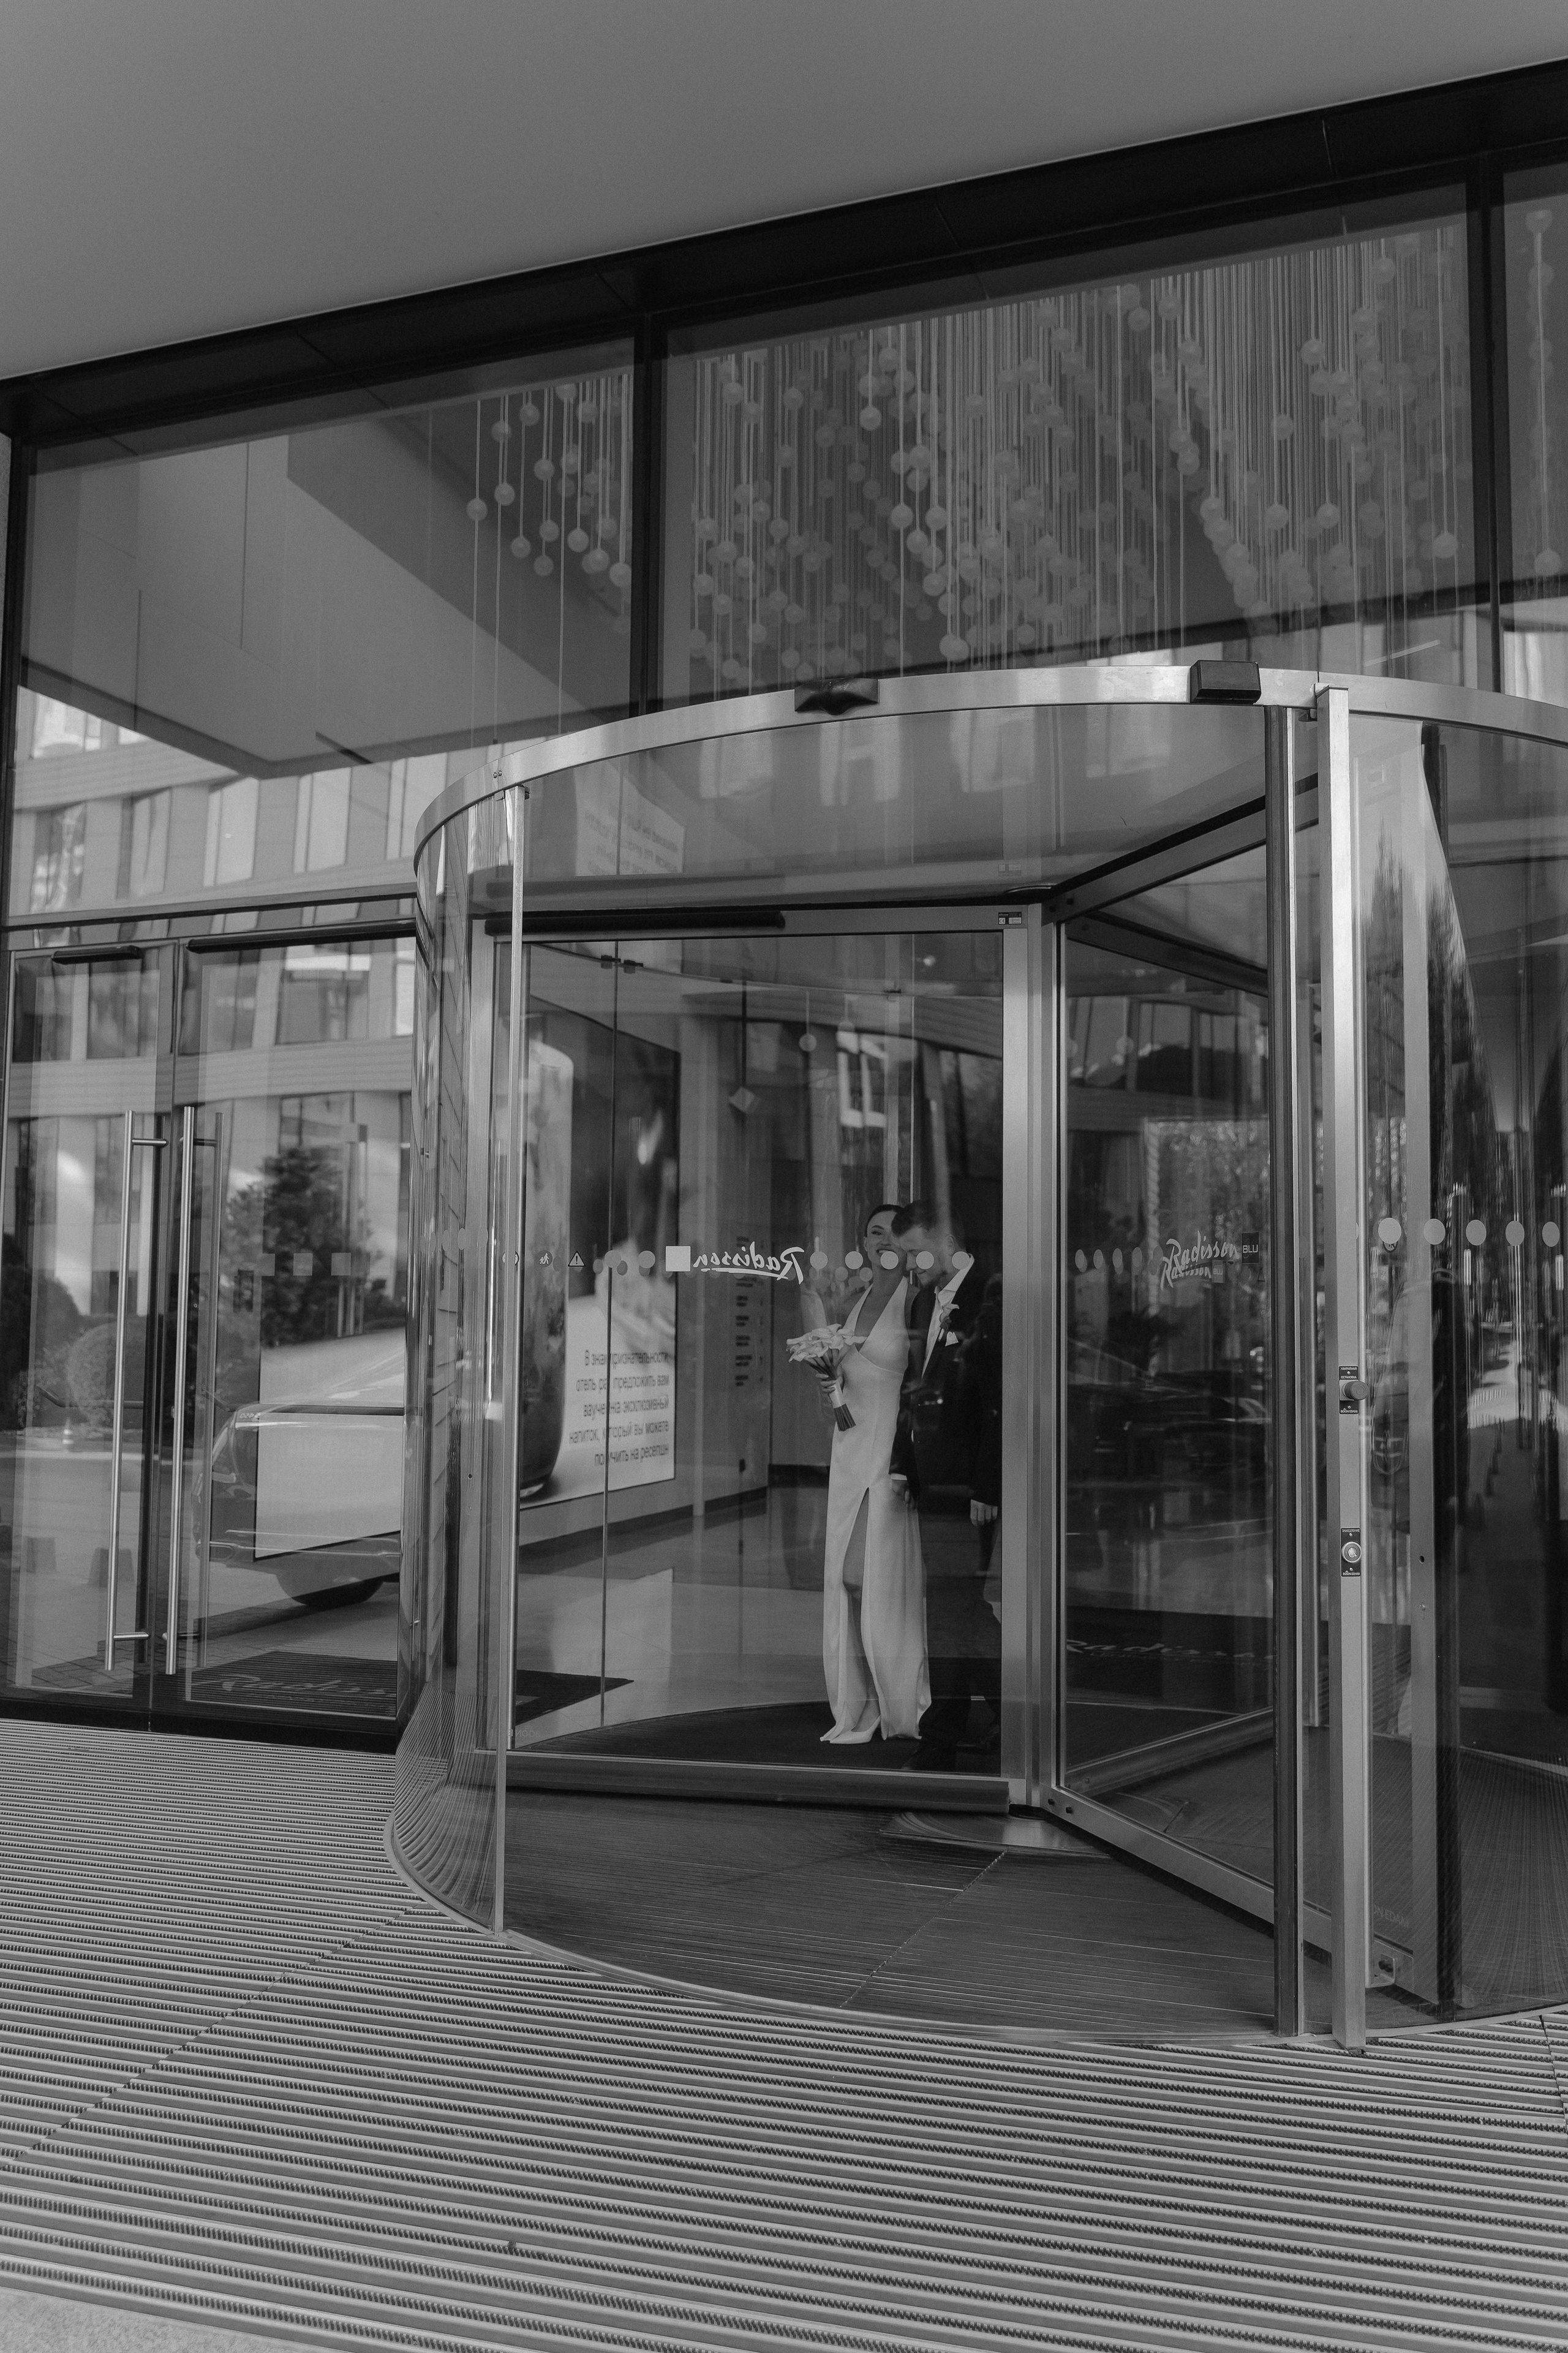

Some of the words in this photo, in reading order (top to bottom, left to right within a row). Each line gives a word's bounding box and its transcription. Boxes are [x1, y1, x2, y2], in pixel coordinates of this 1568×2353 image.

[1166, 1230, 1240, 1274] Radisson
[1242, 1244, 1259, 1253] BLU
[584, 1350, 589, 1365] В
[576, 1378, 597, 1392] отель
[598, 1378, 607, 1394] ра
[583, 1403, 607, 1421] вауче
